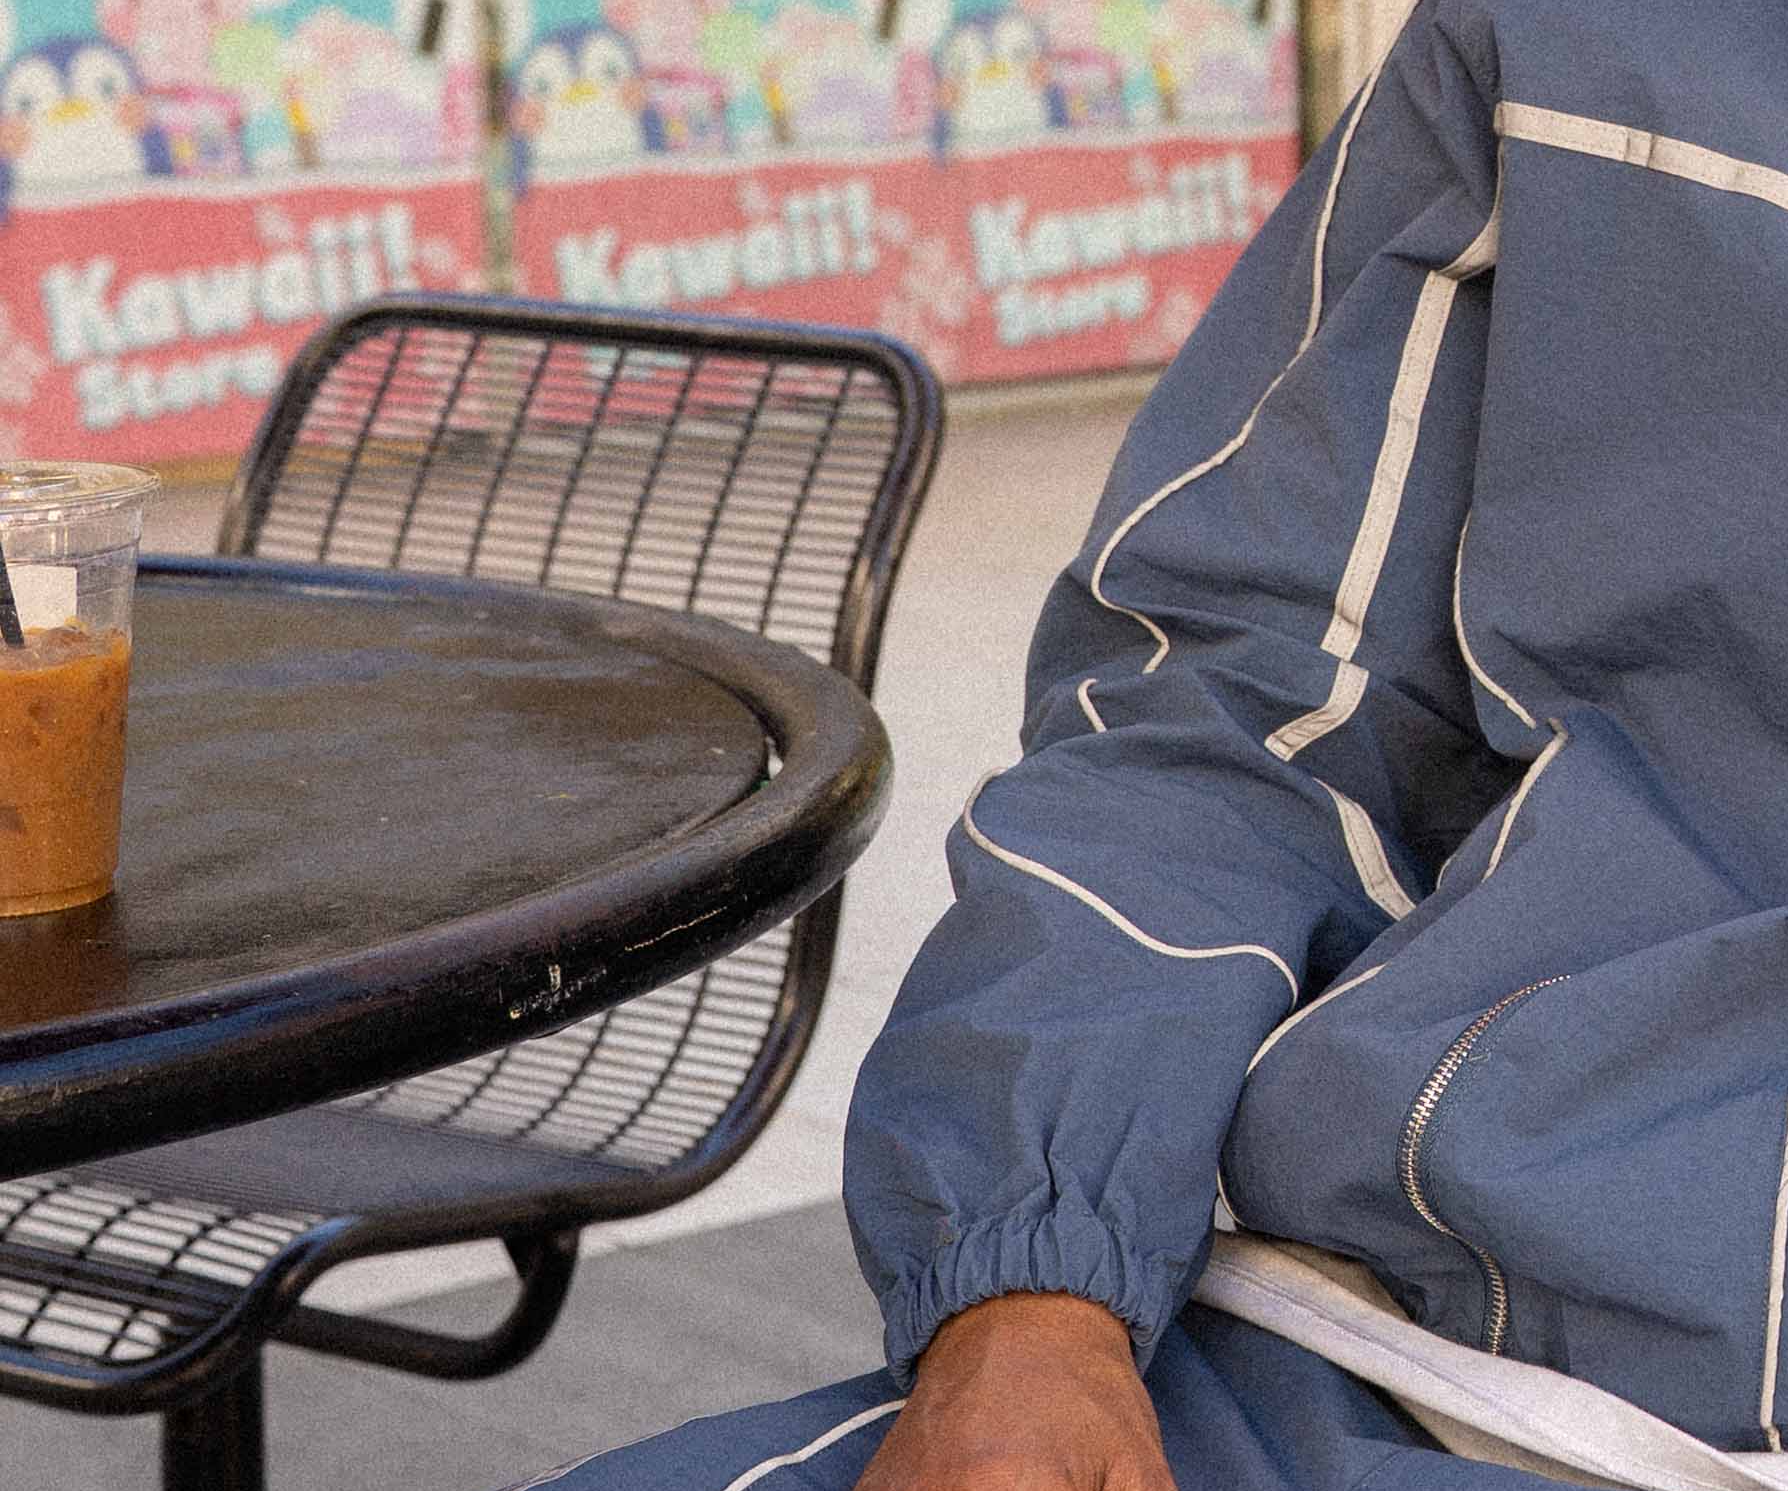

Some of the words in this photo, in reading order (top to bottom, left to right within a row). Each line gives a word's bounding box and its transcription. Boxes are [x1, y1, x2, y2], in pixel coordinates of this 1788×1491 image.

[41, 203, 412, 363] Kawaii!
[556, 177, 878, 308] Kawaii!
[970, 155, 1250, 287] Kawaii!
[997, 275, 1150, 347] Store
[75, 344, 280, 432] Store
